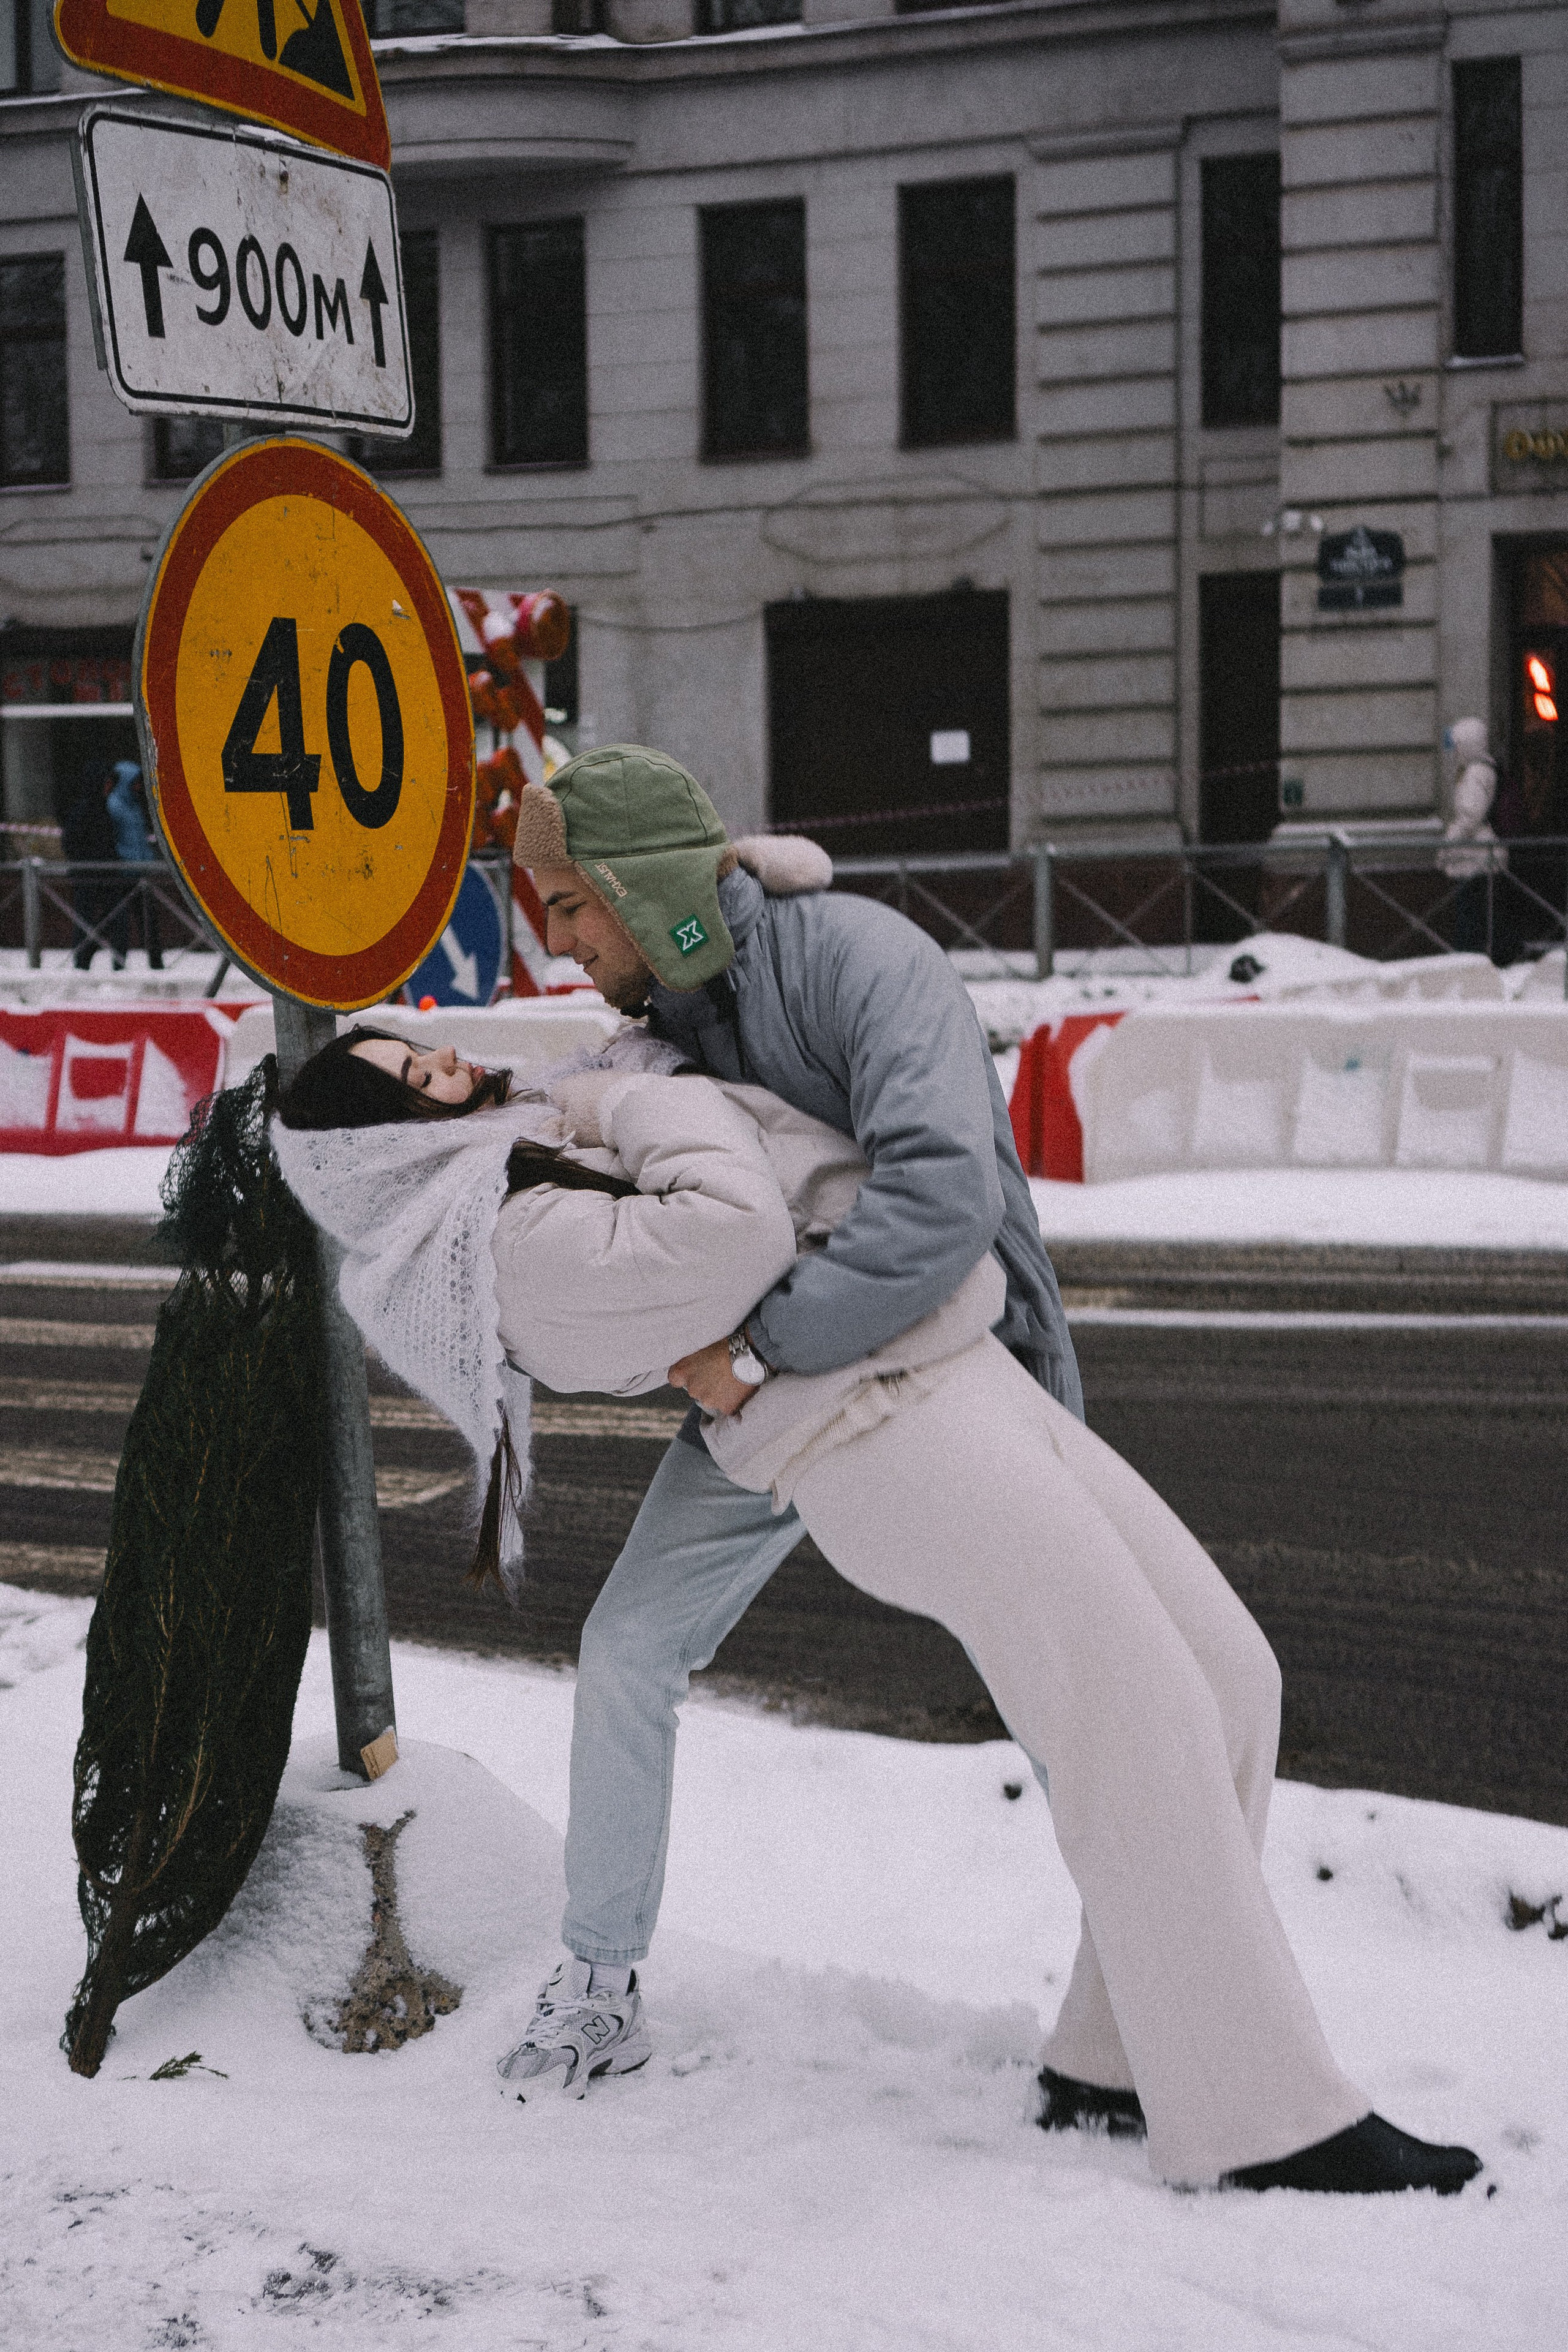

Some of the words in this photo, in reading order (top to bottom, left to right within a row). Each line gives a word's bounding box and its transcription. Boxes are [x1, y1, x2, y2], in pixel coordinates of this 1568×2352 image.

[221, 617, 404, 831] 40
[594, 862, 628, 898] EXHAUST
[581, 2015, 611, 2045] N
